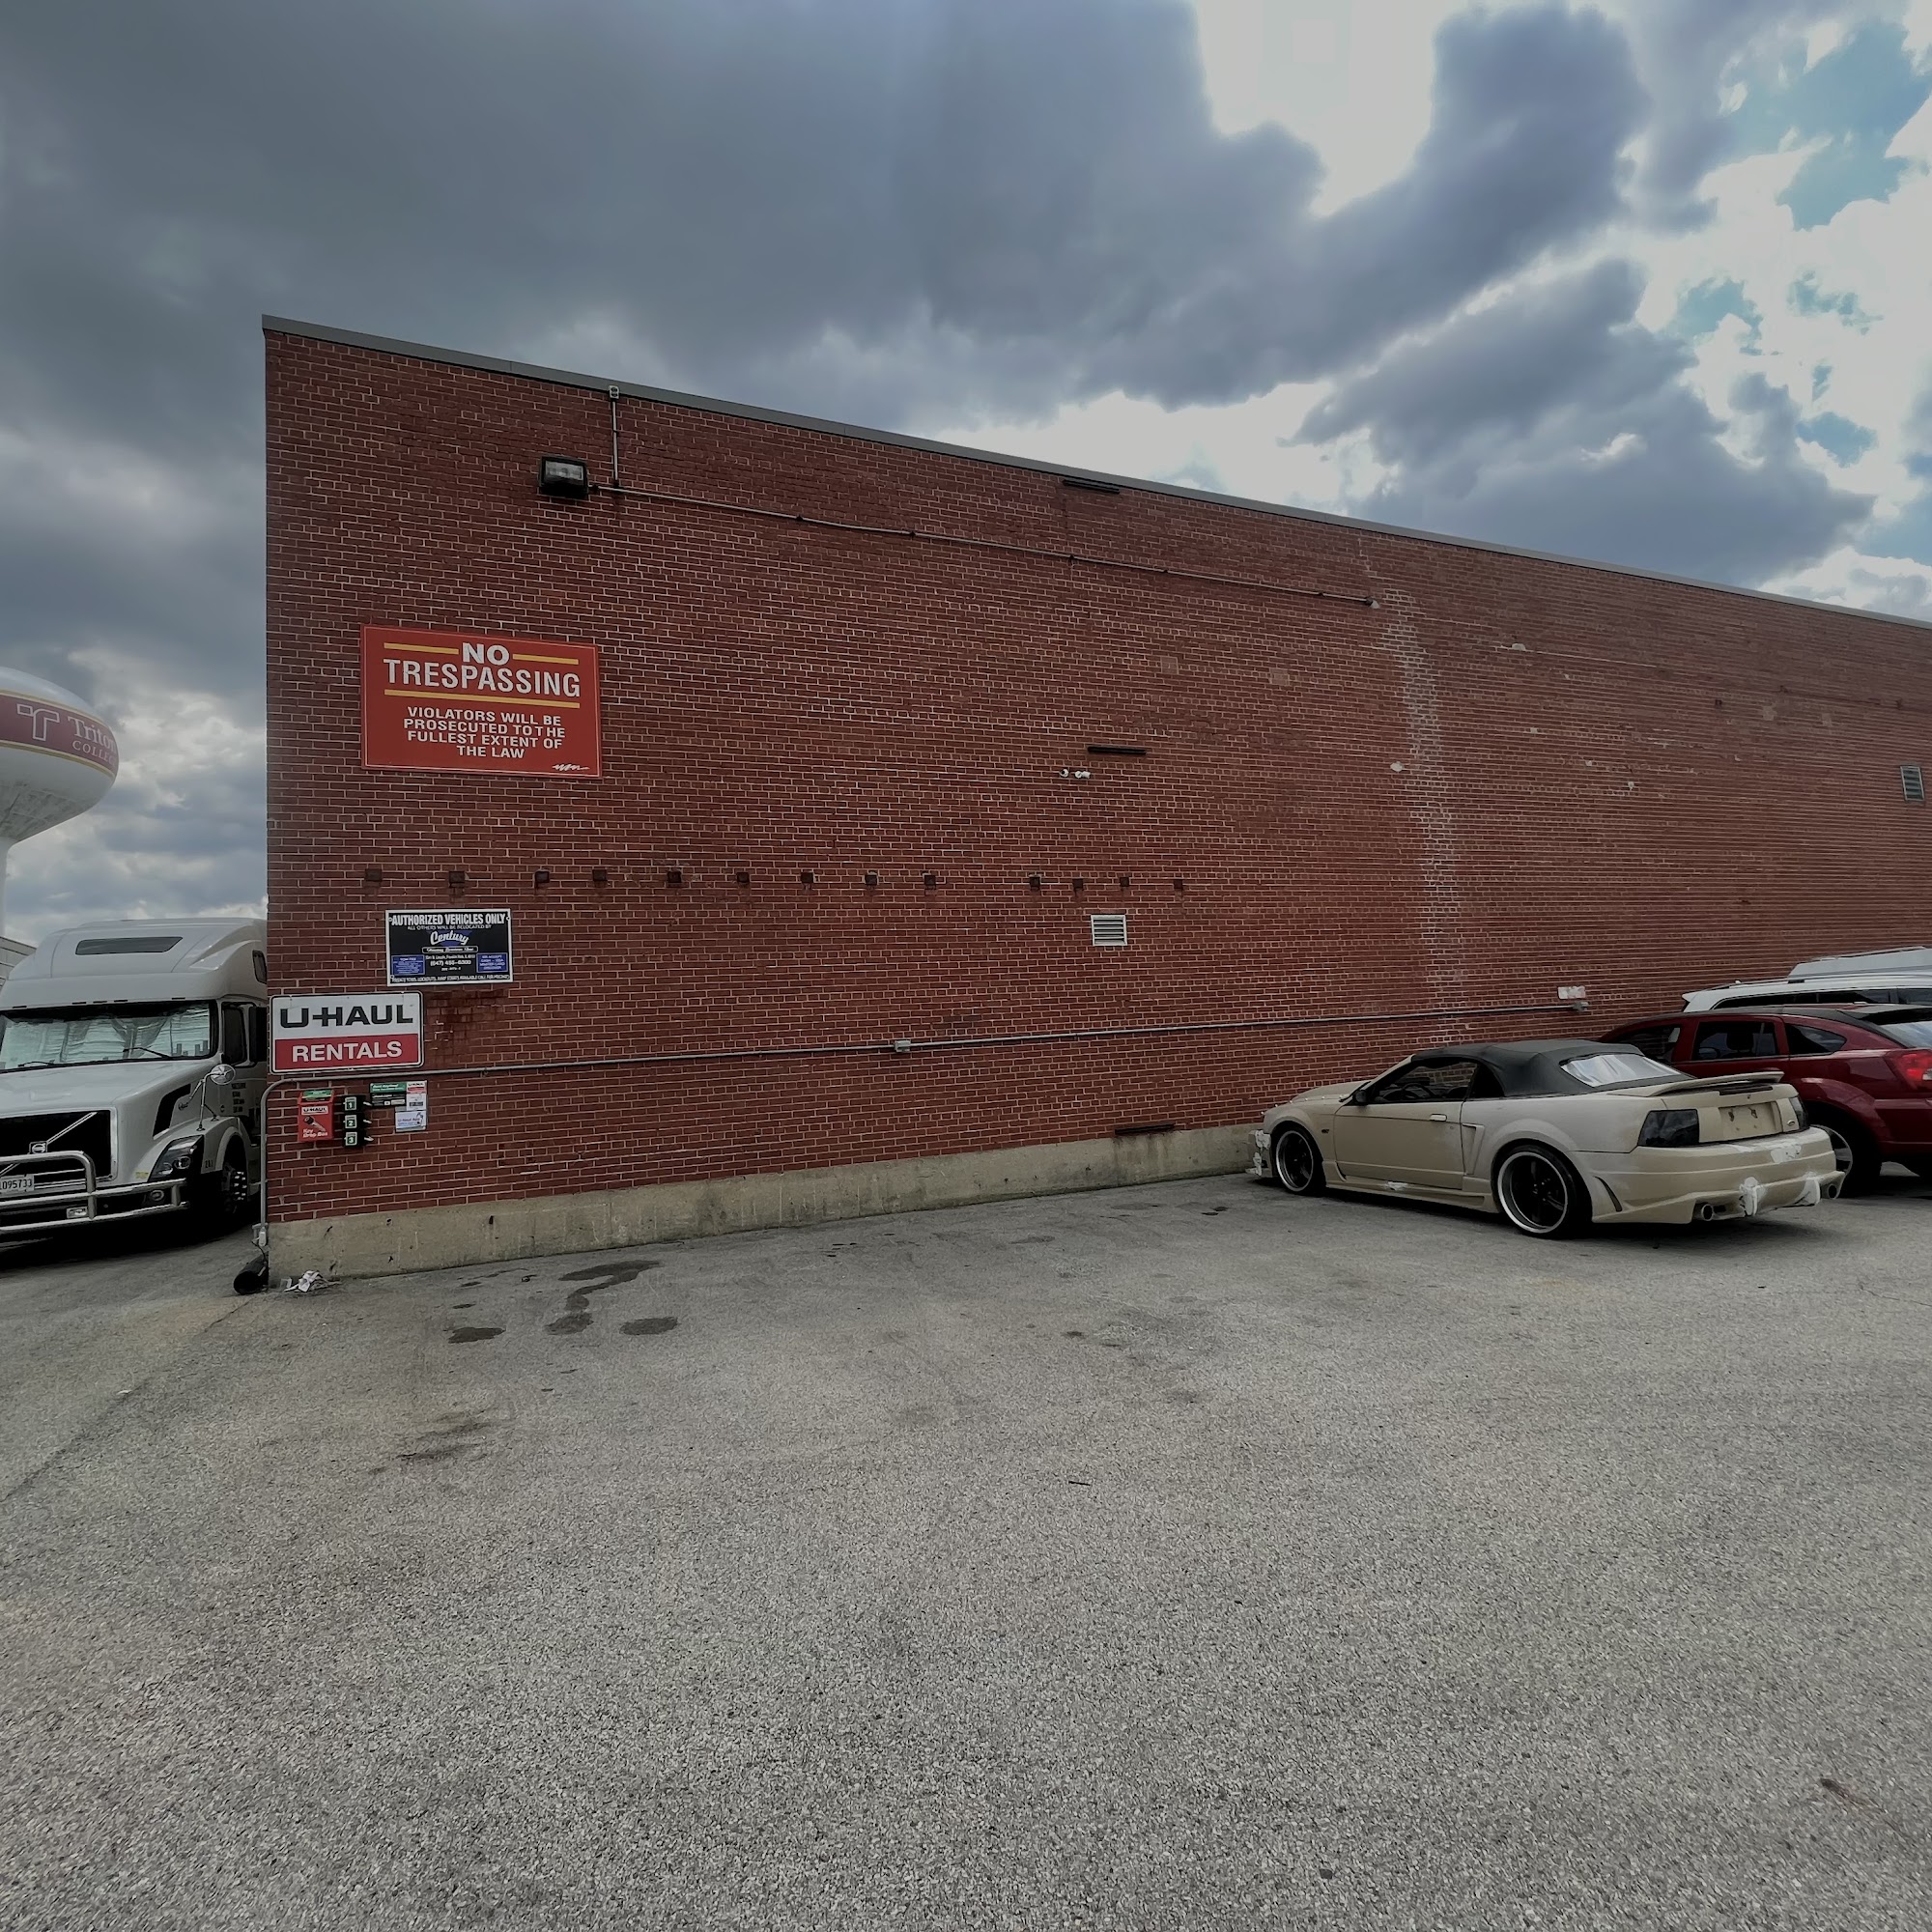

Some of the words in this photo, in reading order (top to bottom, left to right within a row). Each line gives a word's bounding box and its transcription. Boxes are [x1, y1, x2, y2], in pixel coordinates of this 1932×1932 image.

[462, 642, 510, 666] NO
[383, 659, 581, 697] TRESPASSING
[407, 706, 496, 722] VIOLATORS
[500, 713, 541, 725] WILL
[543, 716, 561, 726] BE
[404, 719, 508, 734] PROSECUTED
[514, 725, 532, 737] TO
[536, 726, 565, 738] THE
[408, 731, 476, 745] FULLEST
[482, 734, 538, 749] EXTENT
[543, 738, 563, 750] OF
[456, 745, 487, 757] THE
[491, 747, 525, 759] LAW
[391, 914, 443, 926] AUTHORIZED
[444, 913, 484, 924] VEHICLES
[485, 913, 506, 924] ONLY
[430, 929, 469, 946] Century
[280, 1004, 413, 1029] U-HAUL
[292, 1040, 403, 1063] RENTALS
